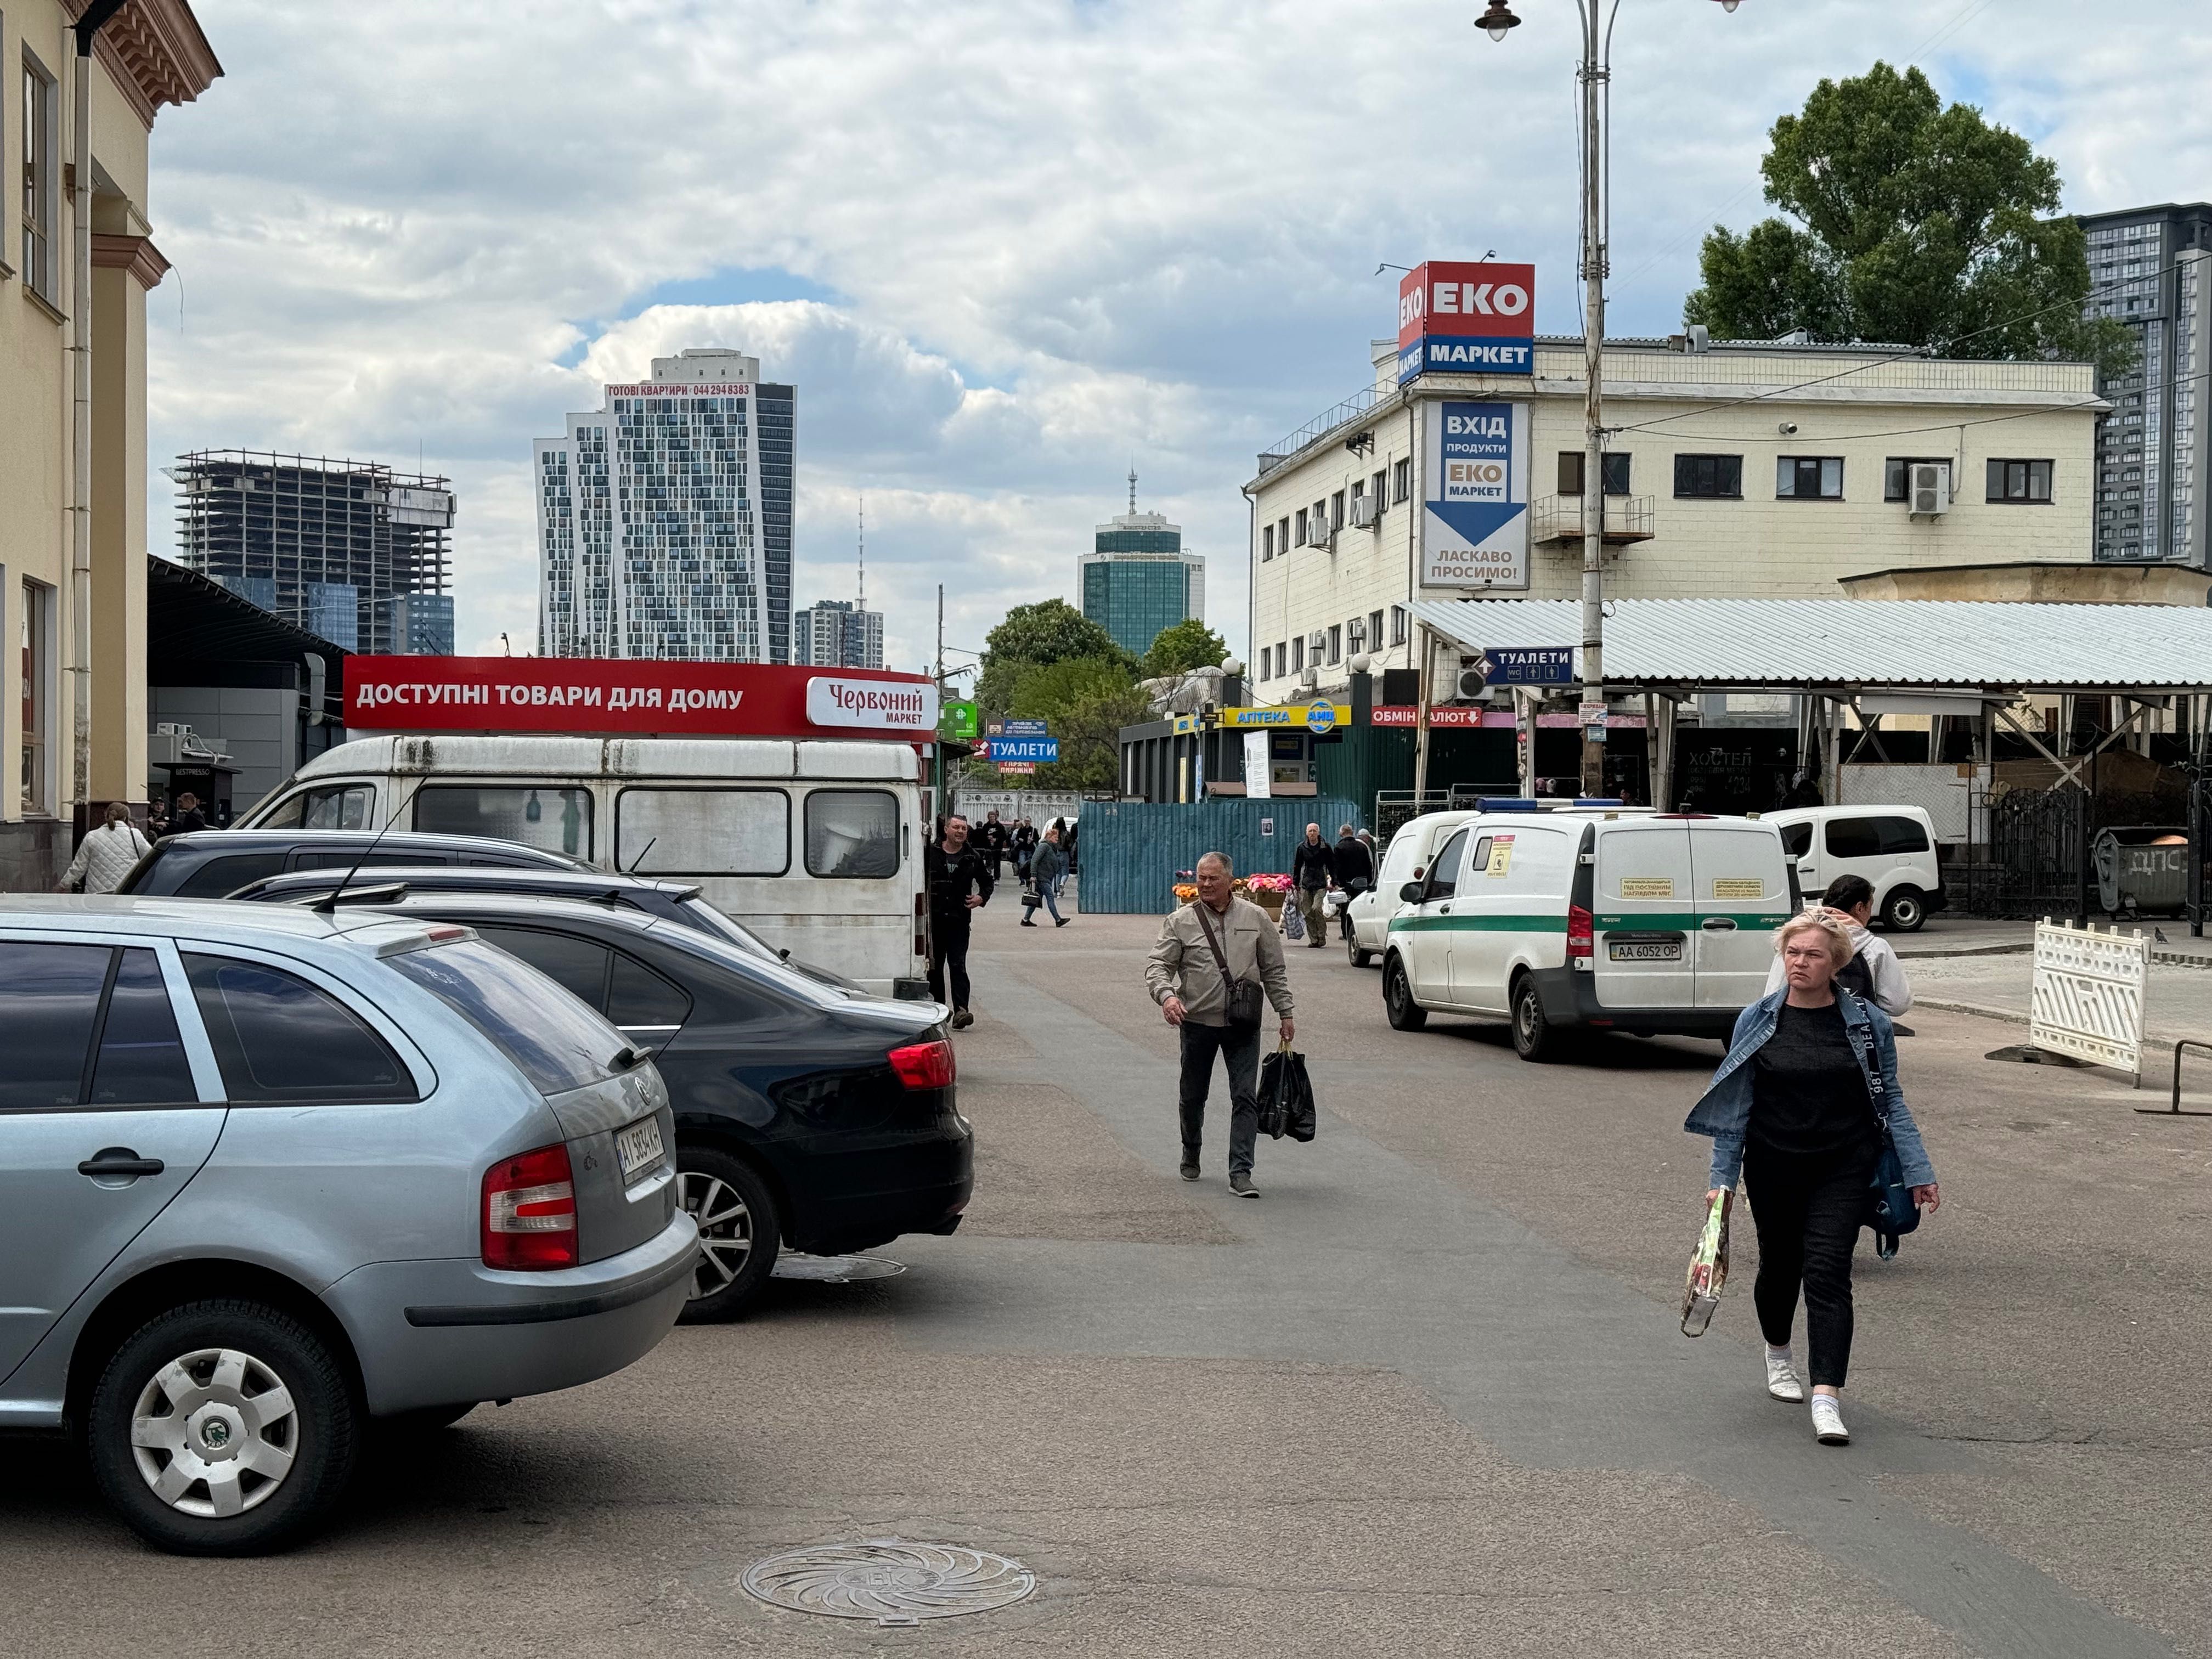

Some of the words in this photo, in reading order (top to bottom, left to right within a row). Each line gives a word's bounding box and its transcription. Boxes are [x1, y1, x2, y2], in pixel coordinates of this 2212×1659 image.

[1433, 282, 1528, 316] ЕКО
[1400, 286, 1423, 330] ЕКО
[1430, 345, 1529, 364] МАРКЕТ
[1399, 346, 1422, 377] МАРКЕТ
[608, 385, 639, 396] ГОТОВІ
[693, 385, 709, 395] 044
[710, 385, 726, 395] 294
[727, 385, 749, 395] 8383
[1447, 415, 1507, 439] ВХІД
[1447, 443, 1507, 454] ПРОДУКТИ
[1449, 464, 1503, 483] ЕКО
[1449, 486, 1503, 496] МАРКЕТ
[1437, 550, 1513, 563] ЛАСКАВО
[1431, 566, 1517, 579] ПРОСИМО!
[1498, 652, 1568, 664] ТУАЛЕТИ
[357, 684, 489, 709] ДОСТУПНІ
[495, 685, 602, 707] ТОВАРИ
[607, 687, 662, 712] ДЛЯ
[668, 689, 743, 713] ДОМУ
[828, 684, 923, 717] Червоний
[886, 712, 923, 725] МАРКЕТ
[1238, 711, 1290, 723] АПТЕКА
[1373, 711, 1416, 723] ОБМІН
[1429, 712, 1467, 723] АЛЮТ
[991, 742, 1057, 756] ТУАЛЕТИ
[1618, 947, 1634, 957] AA
[1637, 946, 1661, 957] 6052
[1663, 946, 1678, 957] OP
[620, 1136, 635, 1168] AI
